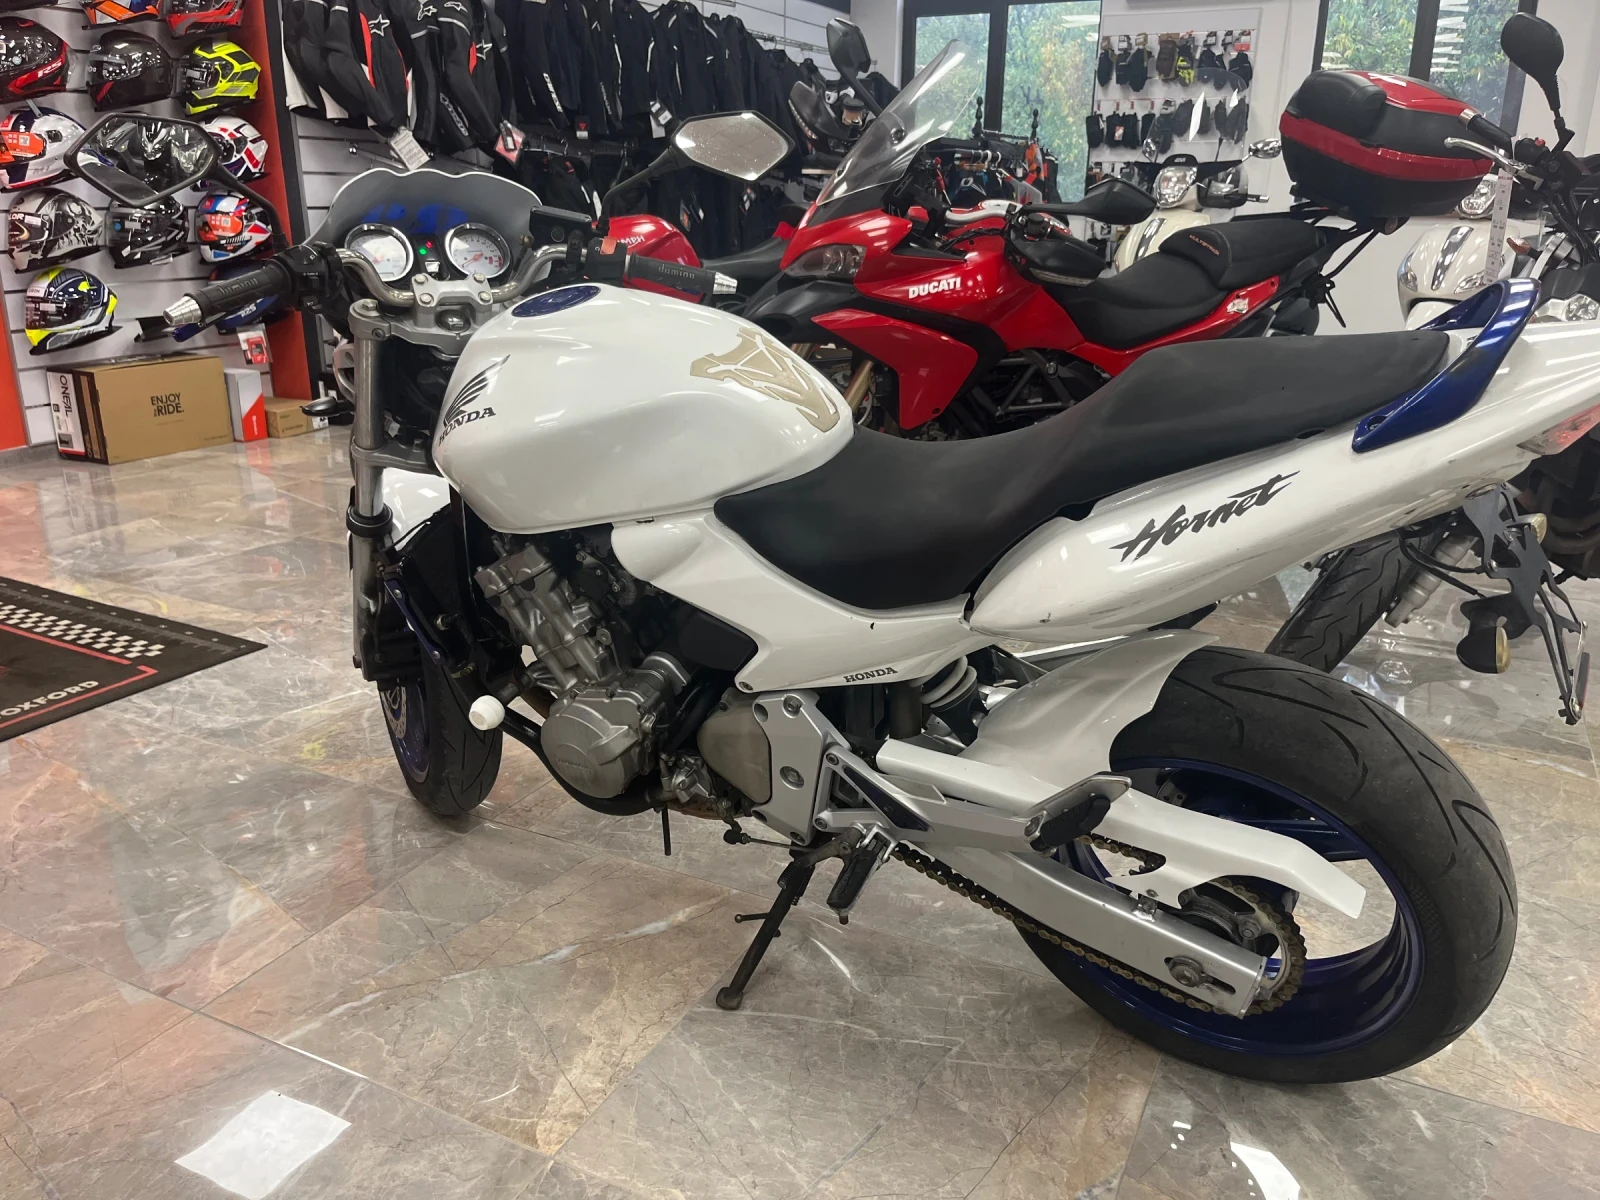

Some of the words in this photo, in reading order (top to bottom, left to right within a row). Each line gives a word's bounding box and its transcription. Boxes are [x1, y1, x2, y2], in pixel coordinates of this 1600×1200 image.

[908, 276, 962, 299] DUCATI
[150, 392, 181, 406] ENJOY
[156, 402, 184, 416] RIDE.
[438, 406, 496, 447] HONDA
[1108, 470, 1301, 564] Hornet
[843, 666, 899, 683] HONDA
[0, 680, 99, 716] OXFORD
